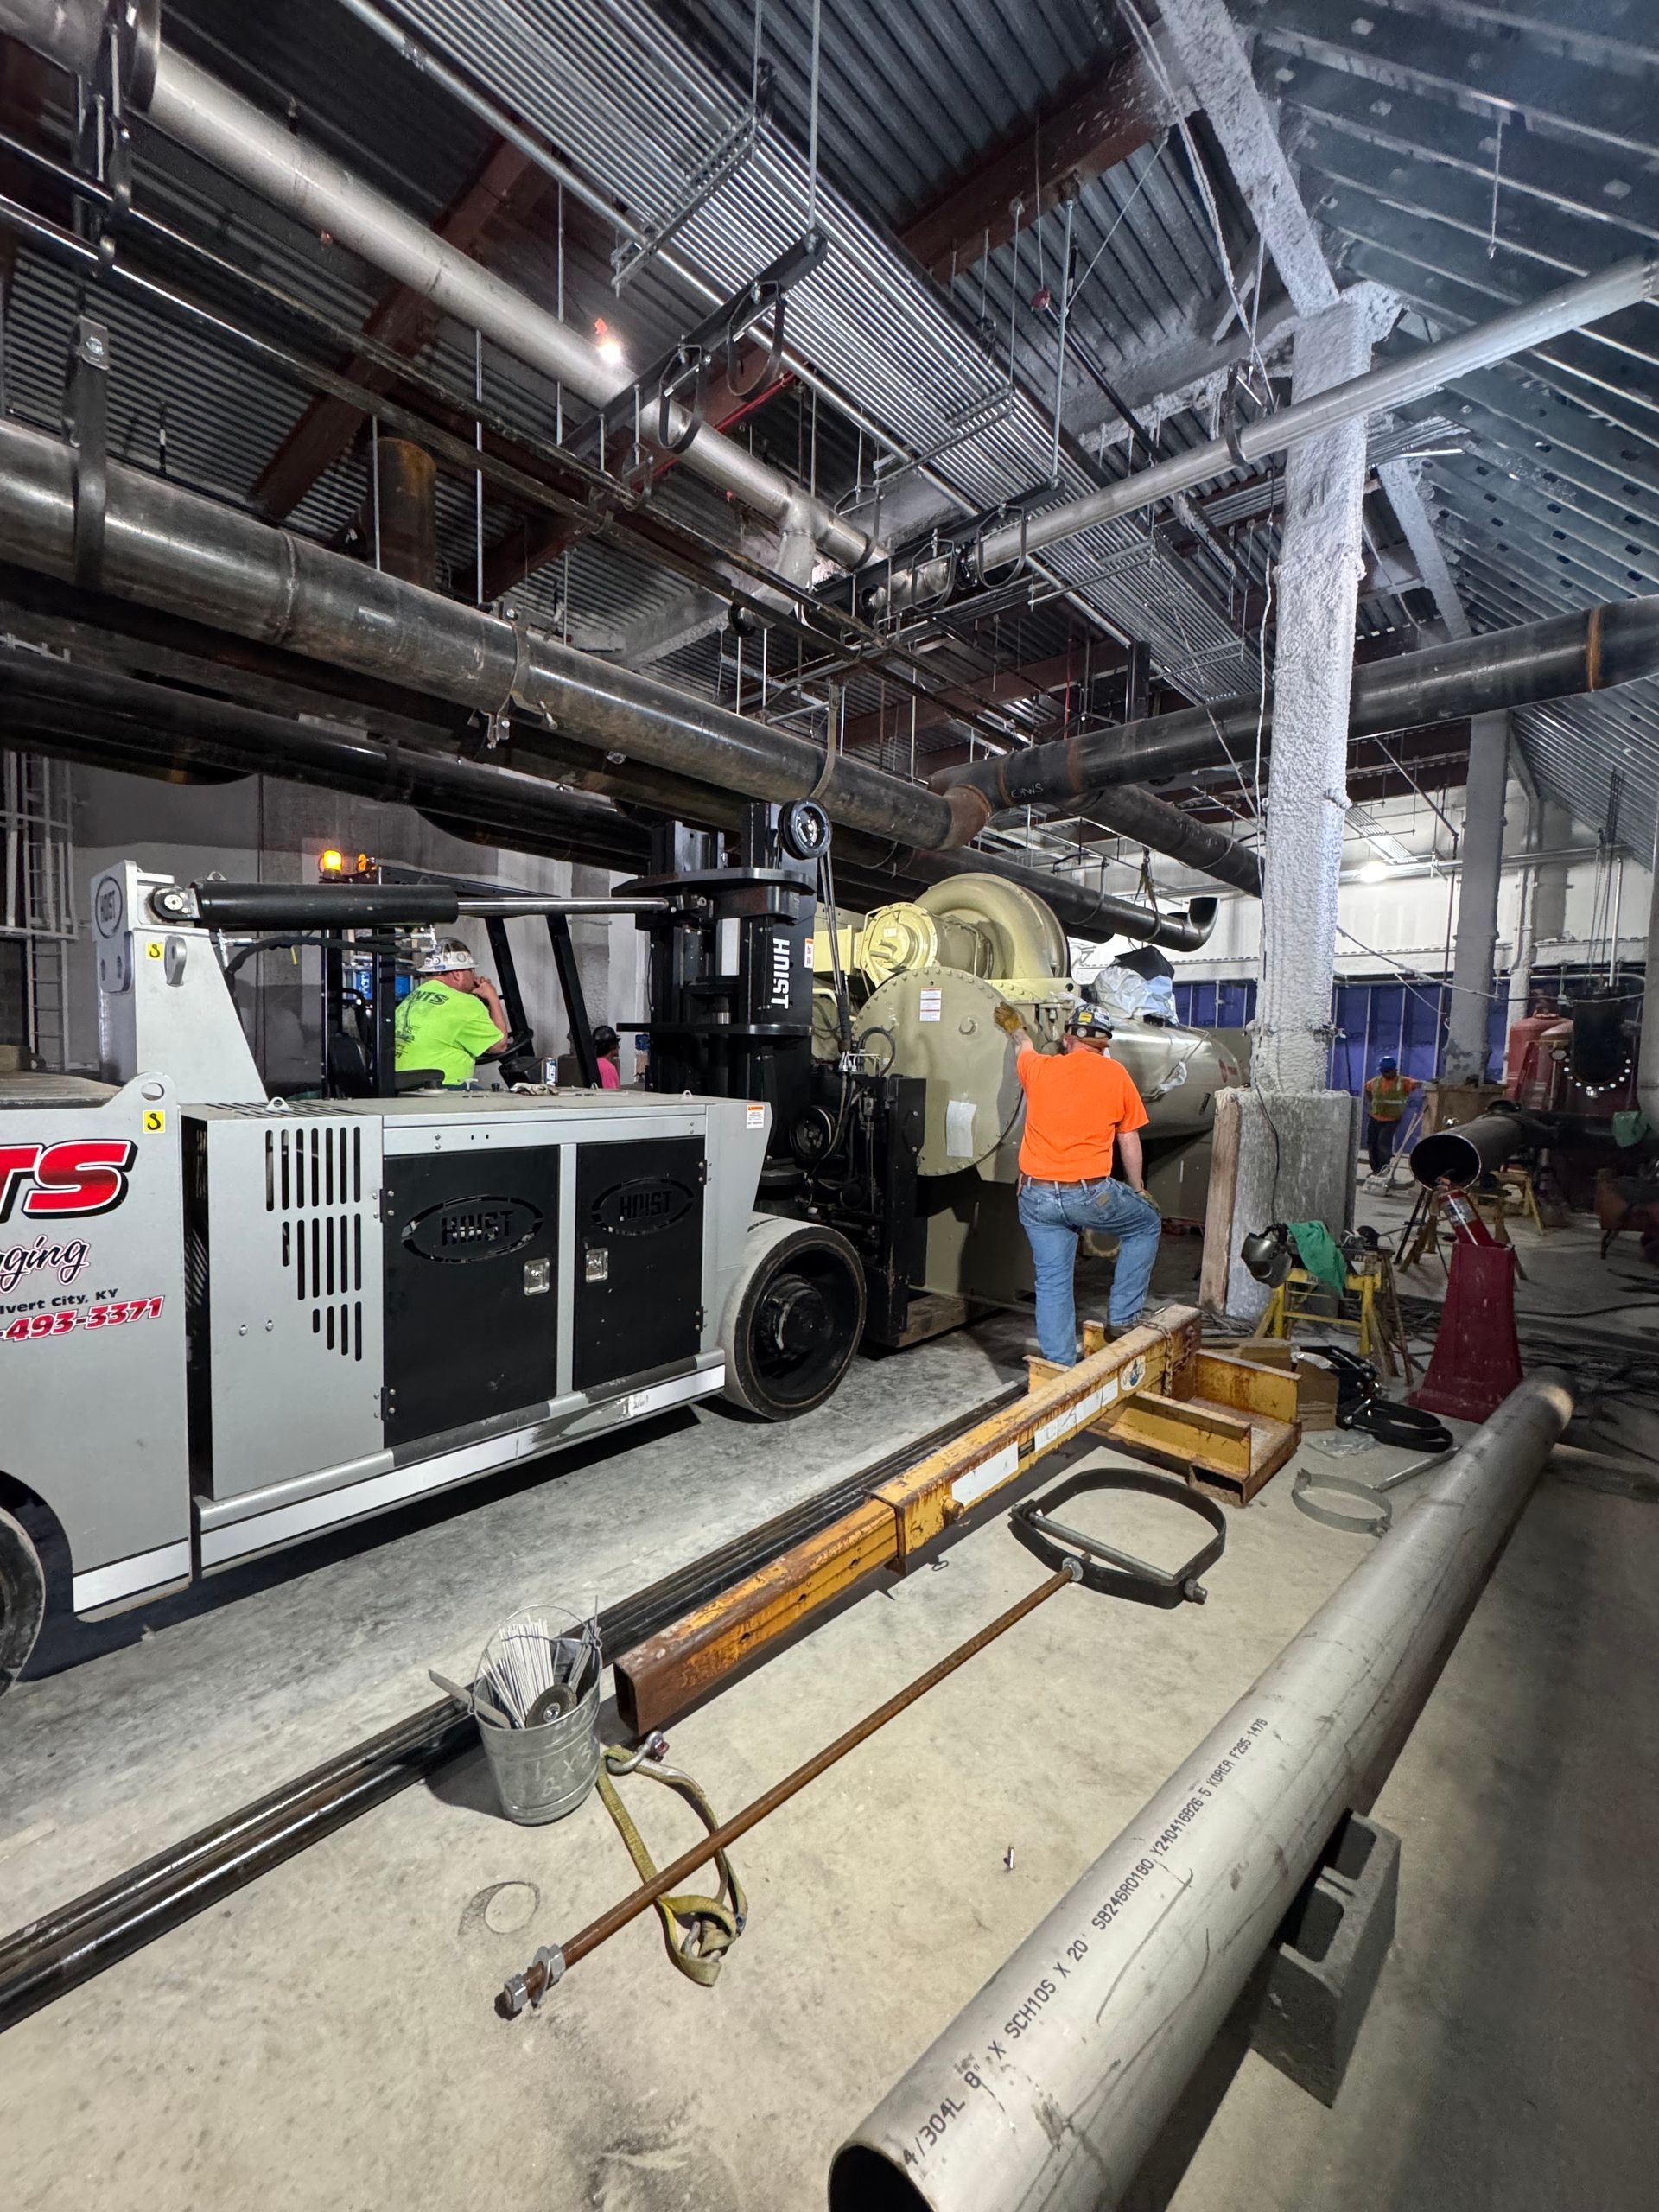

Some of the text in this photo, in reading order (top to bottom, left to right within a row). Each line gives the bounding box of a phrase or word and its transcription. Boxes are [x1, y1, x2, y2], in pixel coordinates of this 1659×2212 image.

[771, 938, 790, 1009] HOIST
[408, 991, 449, 1005] NTS
[442, 1211, 514, 1246] HOIST
[0, 1235, 90, 1294] ging
[51, 1294, 89, 1307] City,
[95, 1288, 118, 1300] KY
[987, 2040, 1007, 2061] X
[1004, 1979, 1057, 2039] SCH10S
[1052, 1961, 1071, 1980] X
[1206, 1759, 1236, 1789] KOREA
